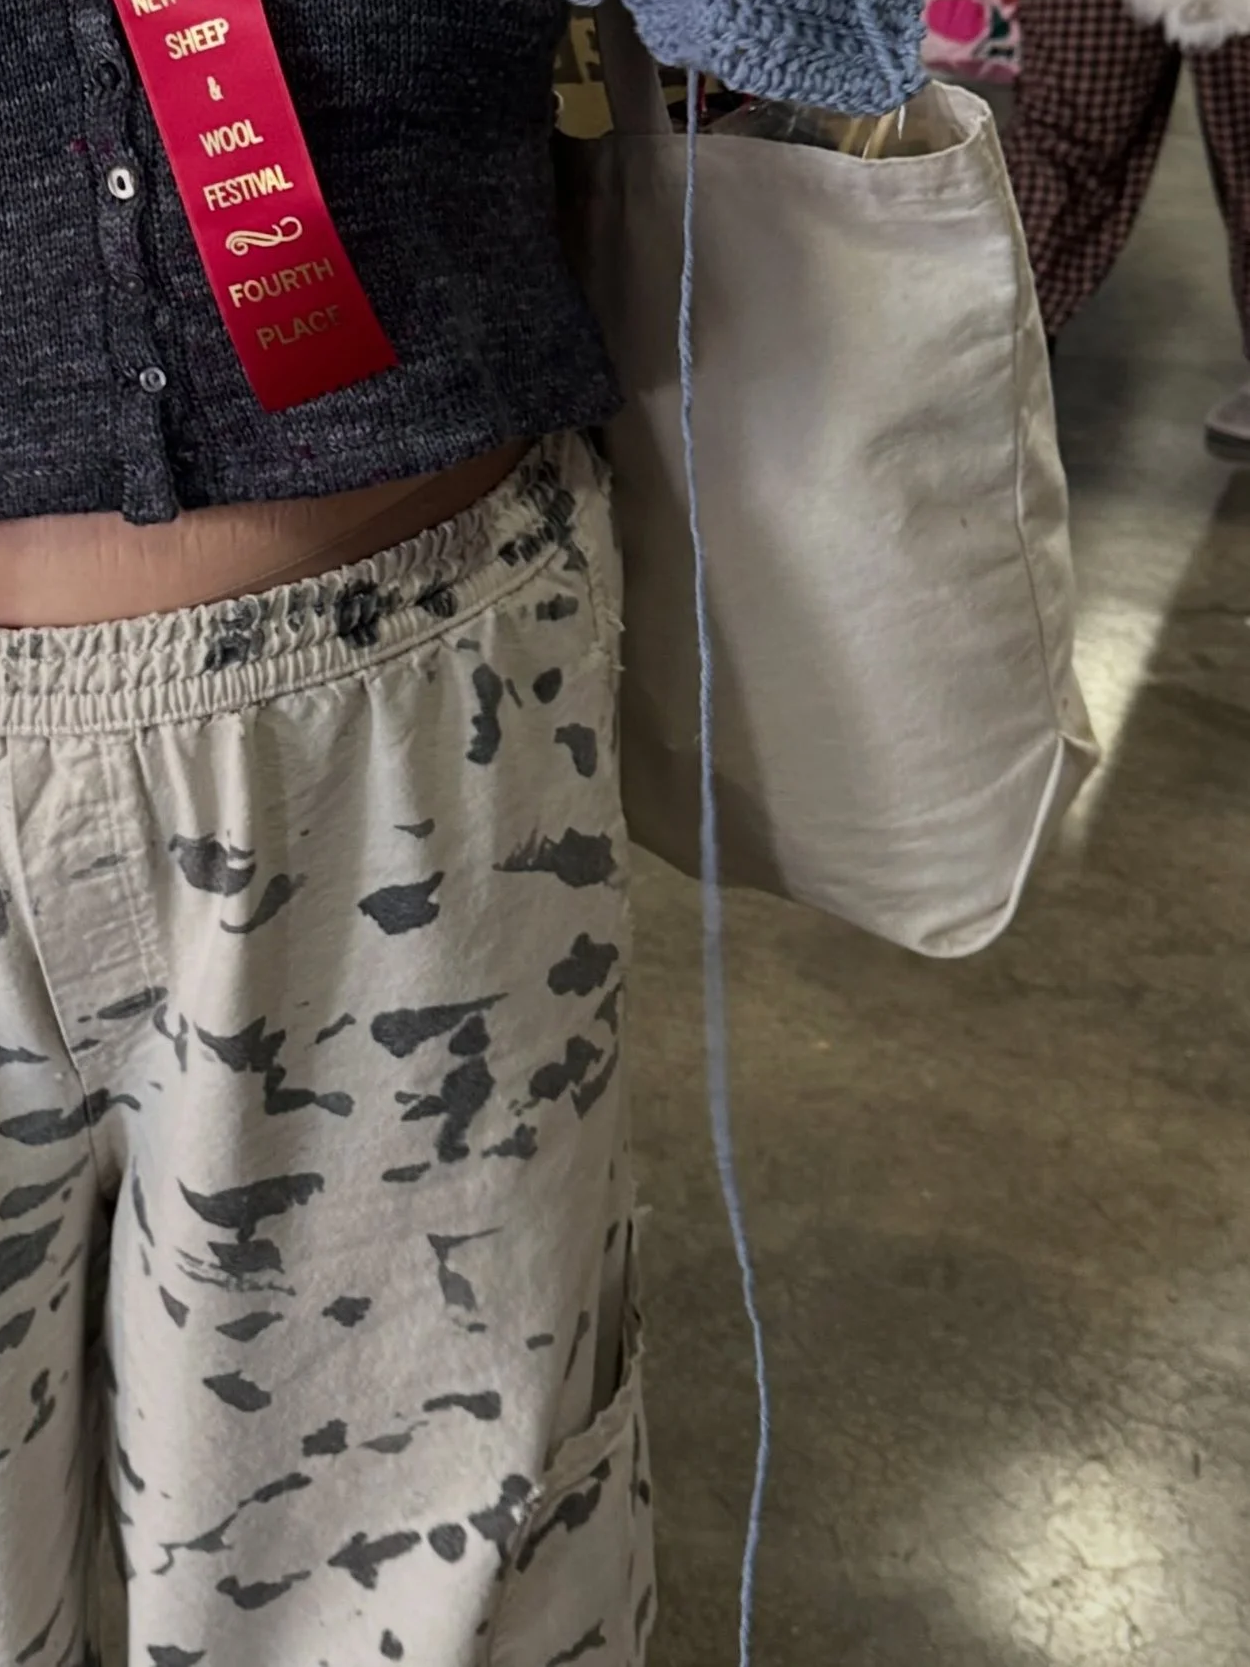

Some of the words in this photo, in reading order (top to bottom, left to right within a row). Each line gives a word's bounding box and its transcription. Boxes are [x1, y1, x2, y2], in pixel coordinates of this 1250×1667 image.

[165, 17, 230, 60] SHEEP
[206, 76, 224, 101] &
[199, 119, 264, 158] WOOL
[203, 164, 294, 212] FESTIVAL
[228, 257, 335, 308] FOURTH
[256, 304, 342, 351] PLACE
